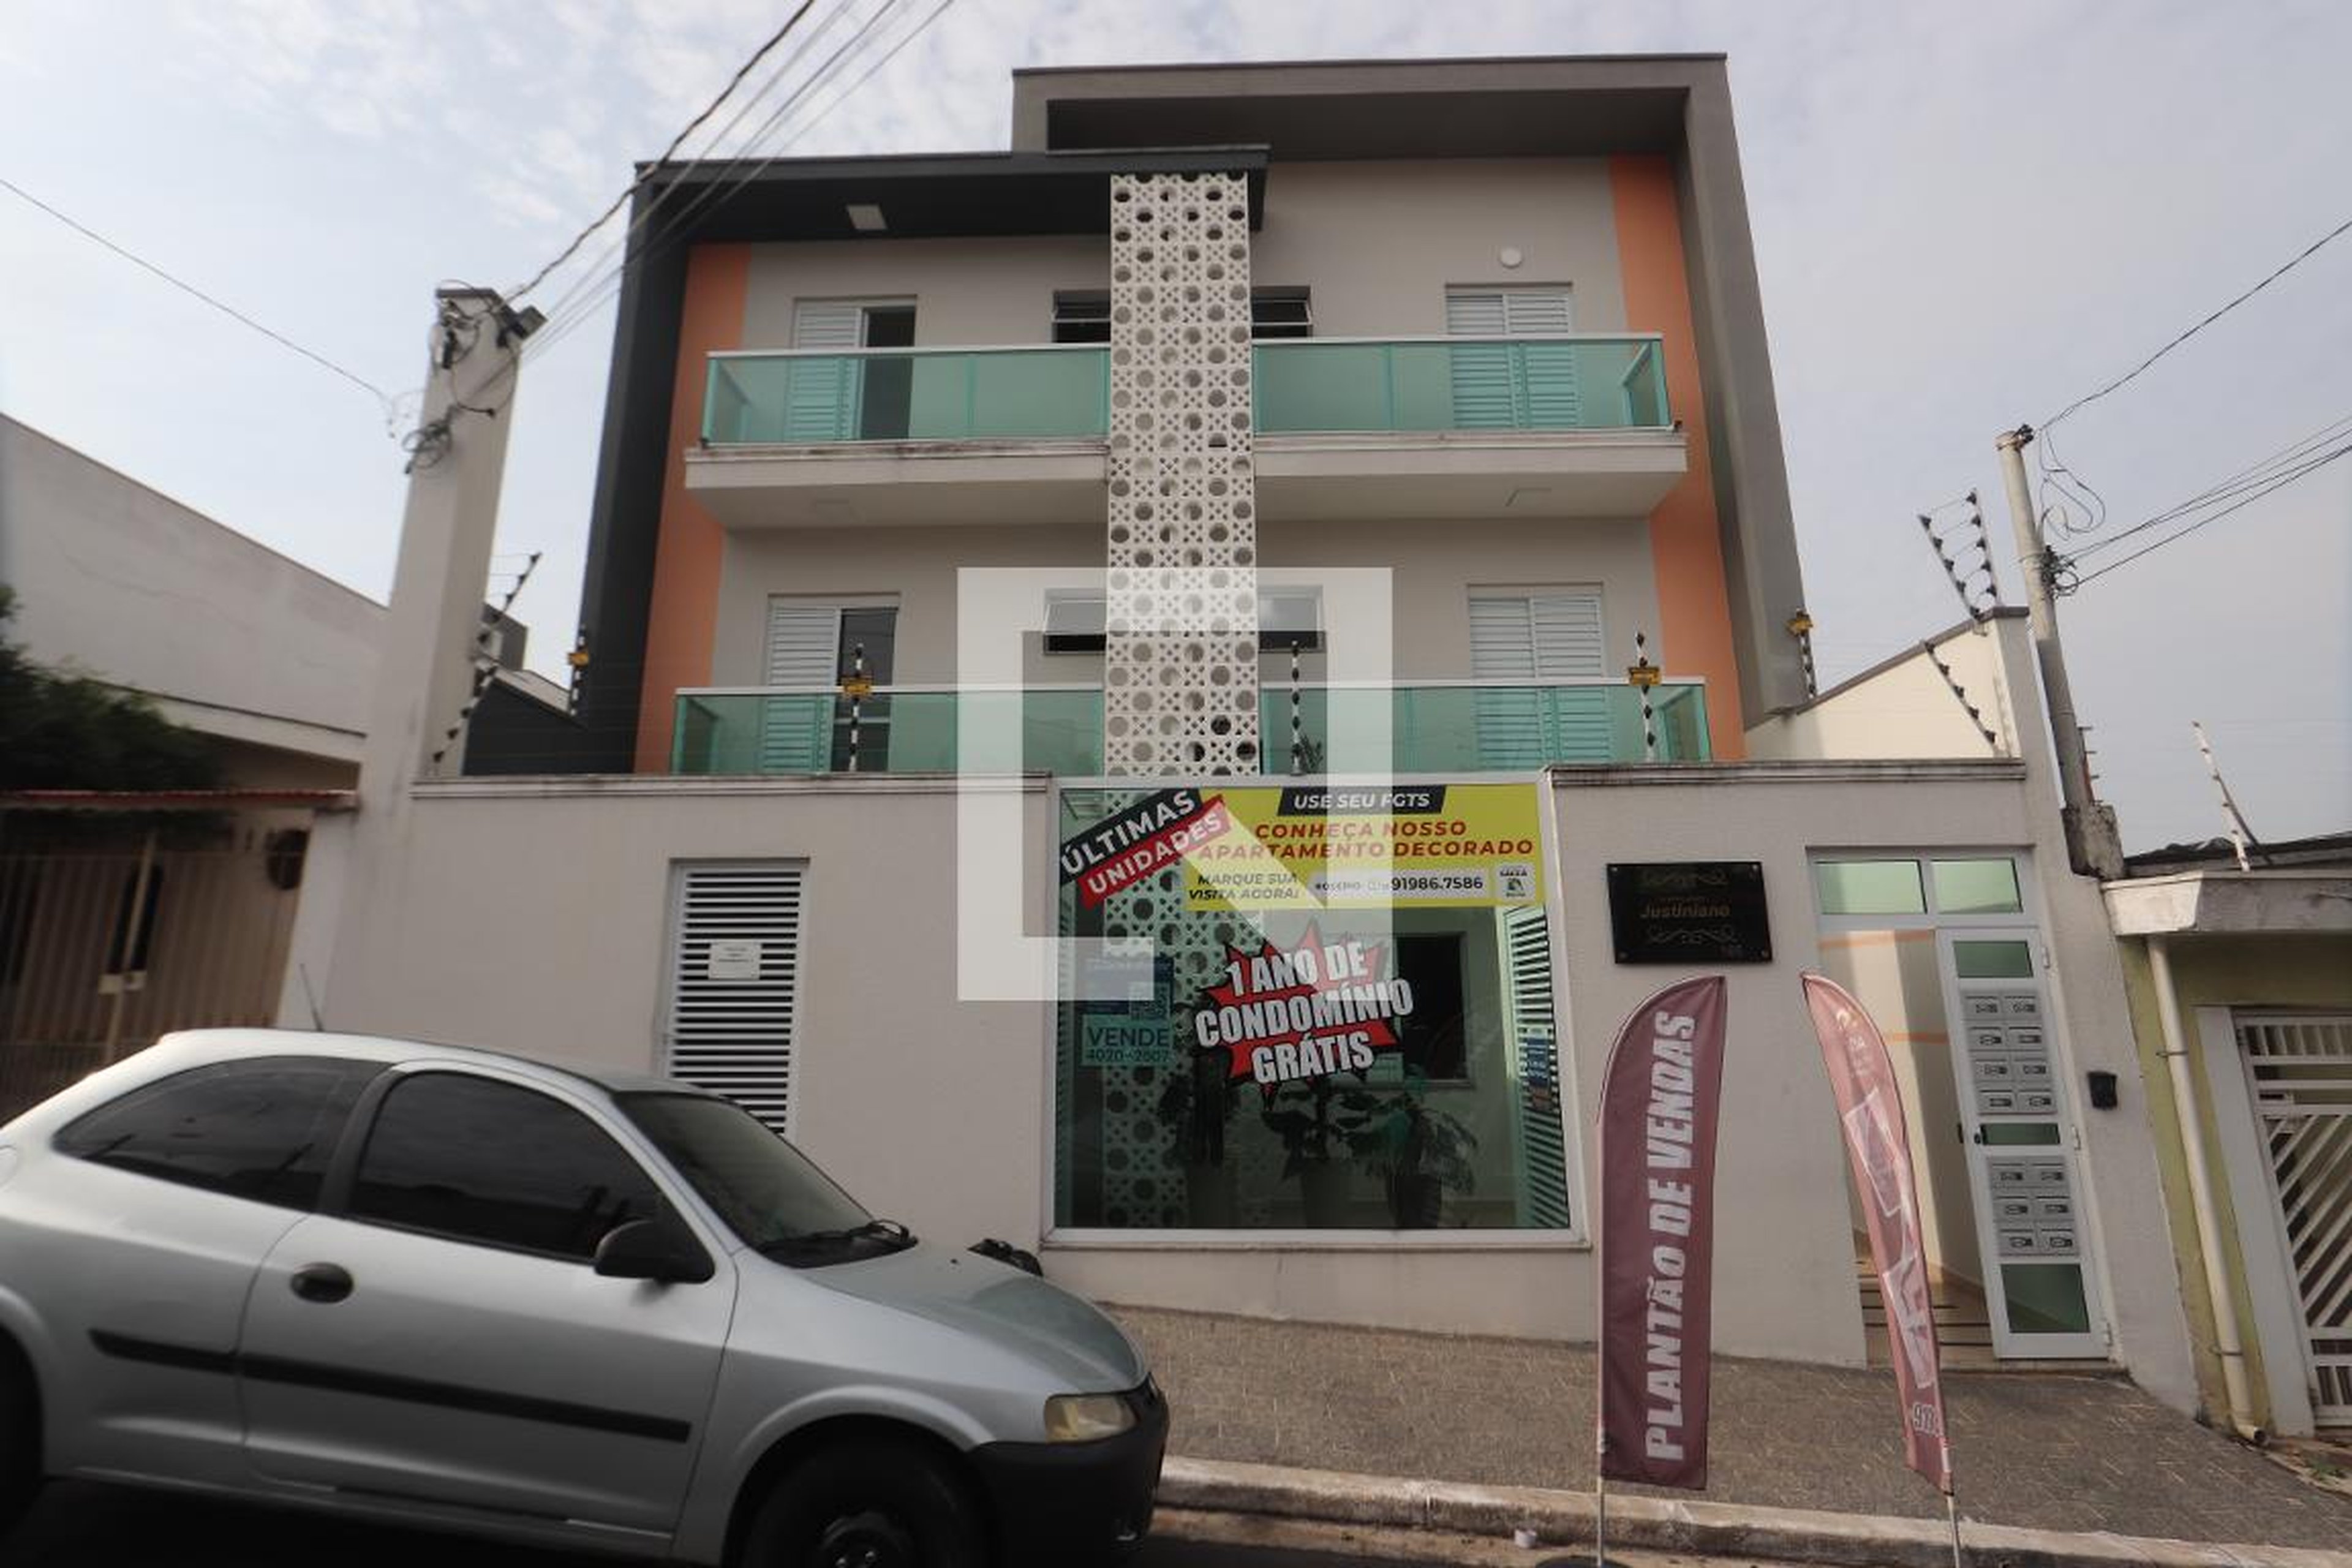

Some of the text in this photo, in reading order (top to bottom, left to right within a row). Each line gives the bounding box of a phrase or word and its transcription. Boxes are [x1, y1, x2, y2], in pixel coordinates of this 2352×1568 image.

[1294, 793, 1431, 809] USE SEU FGTS
[1061, 790, 1195, 875] ÚLTIMAS
[1255, 820, 1467, 840] CONHEÇA NOSSO
[1087, 812, 1223, 894] UNIDADES
[1200, 839, 1533, 859] APARTAMENTO DECORADO
[1197, 873, 1265, 886] MARQUE
[1391, 876, 1483, 890] 91986.7586
[1640, 902, 1732, 918] Justiniano
[1225, 941, 1370, 997] 1 ANO DE
[1195, 978, 1414, 1048] CONDOMÍNIO
[1087, 1027, 1170, 1047] VENDE
[1251, 1031, 1374, 1084] GRÁTIS
[1645, 1011, 1695, 1461] PLANTÃO DE VENDAS
